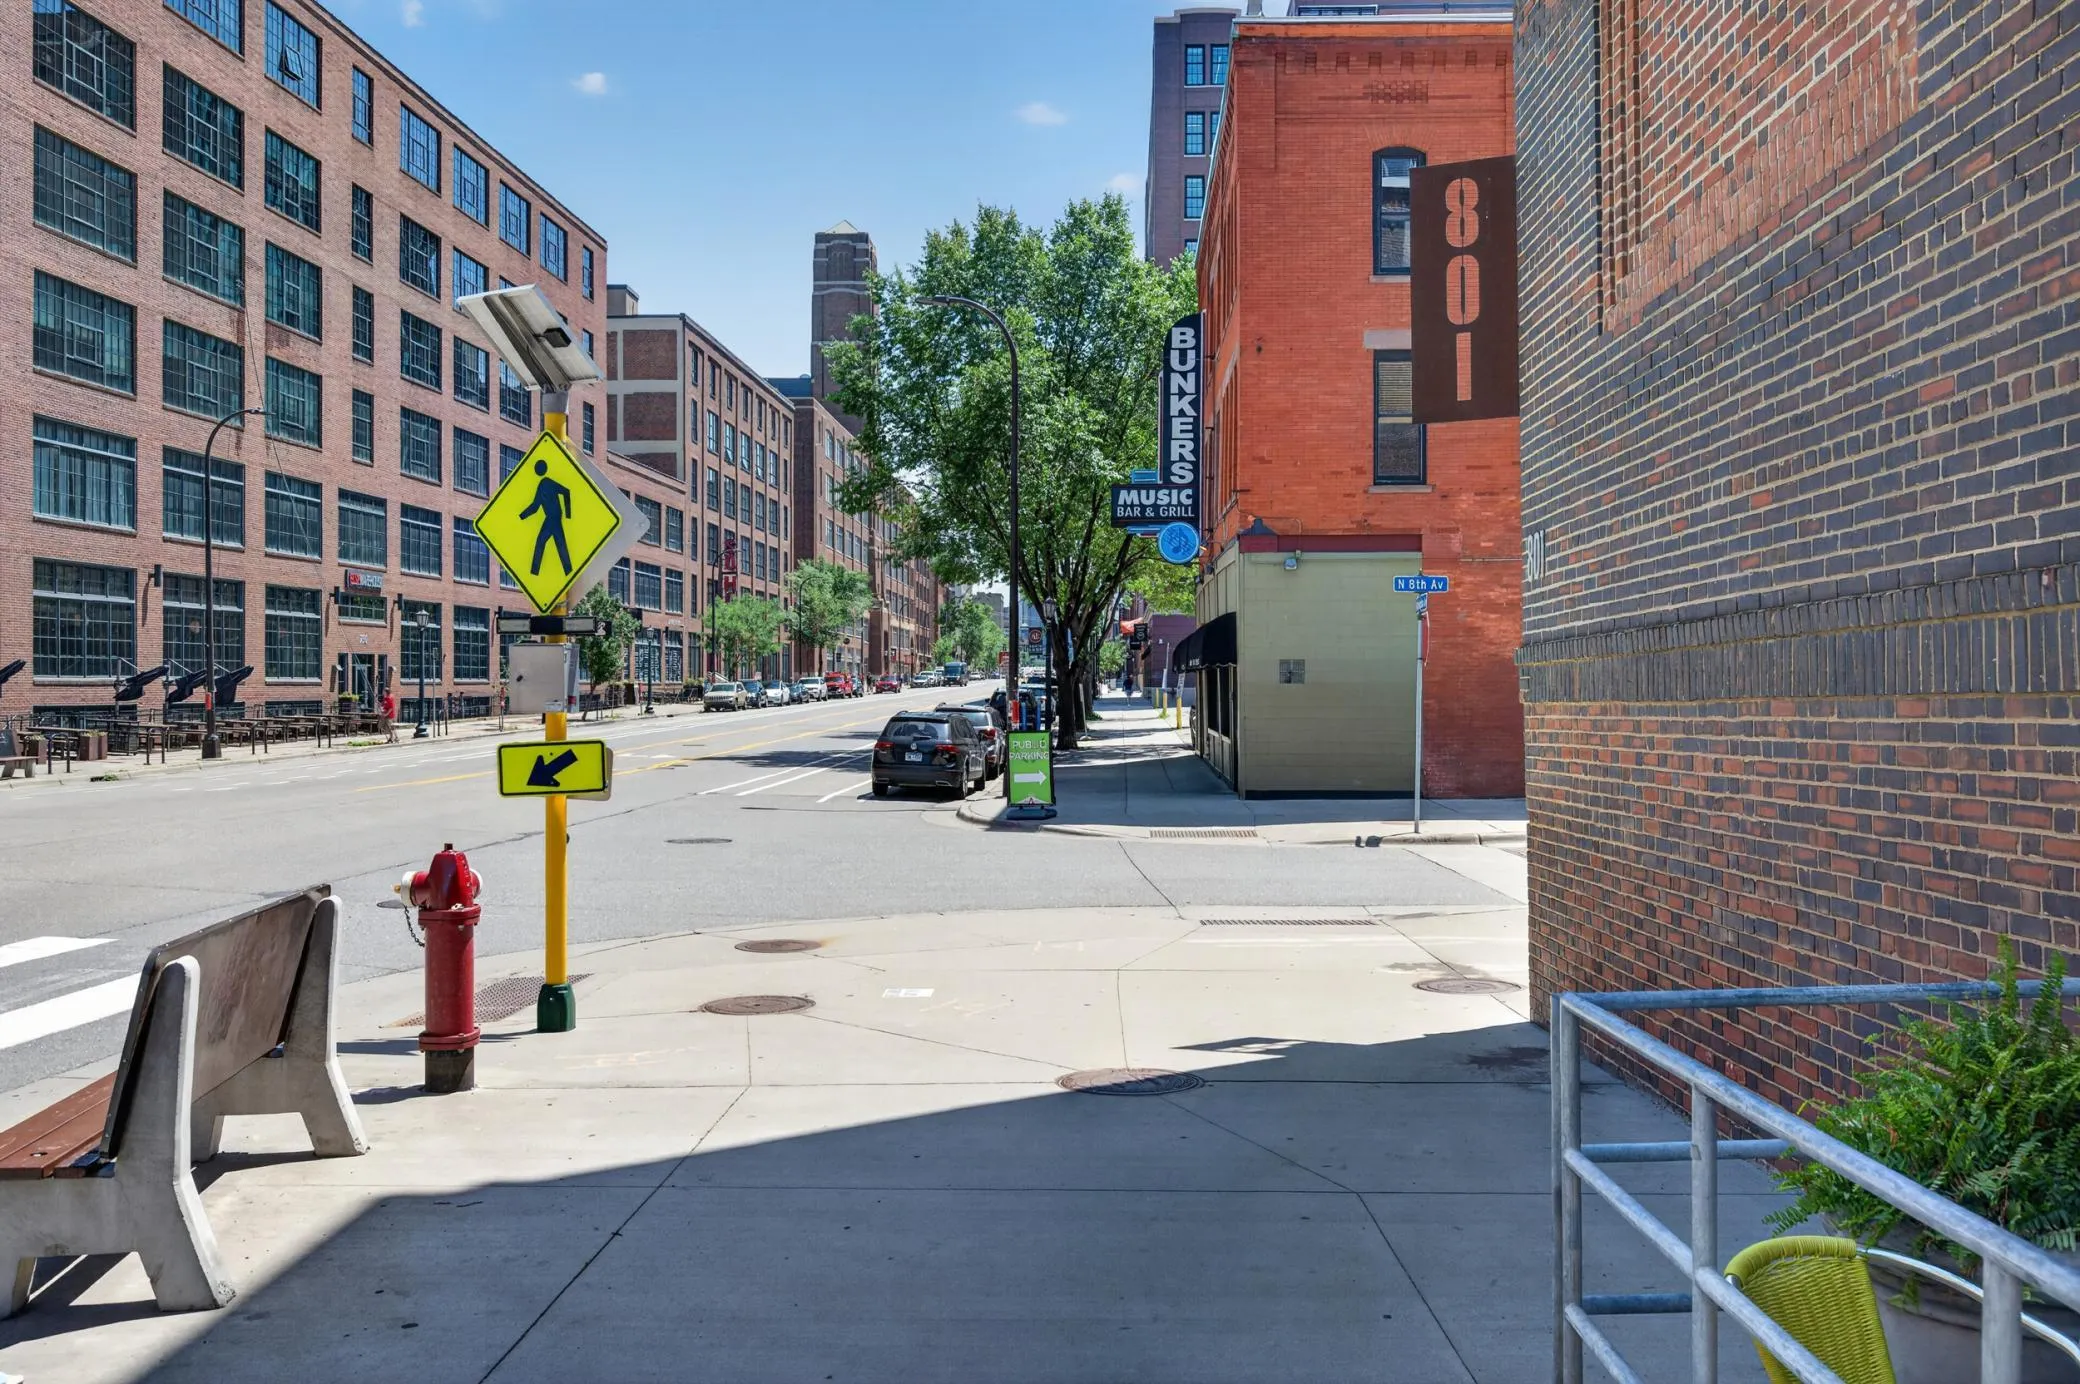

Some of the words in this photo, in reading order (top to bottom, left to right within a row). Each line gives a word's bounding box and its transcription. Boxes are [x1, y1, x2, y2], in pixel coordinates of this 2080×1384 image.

[1169, 326, 1198, 485] BUNKERS
[1117, 488, 1193, 506] MUSIC
[1117, 506, 1141, 517] BAR
[1145, 506, 1155, 517] &
[1160, 506, 1195, 517] GRILL
[1527, 529, 1545, 583] 801
[1398, 578, 1405, 590] N
[1408, 578, 1427, 590] 8th
[1430, 578, 1444, 590] Av
[1008, 751, 1049, 760] PARKING
